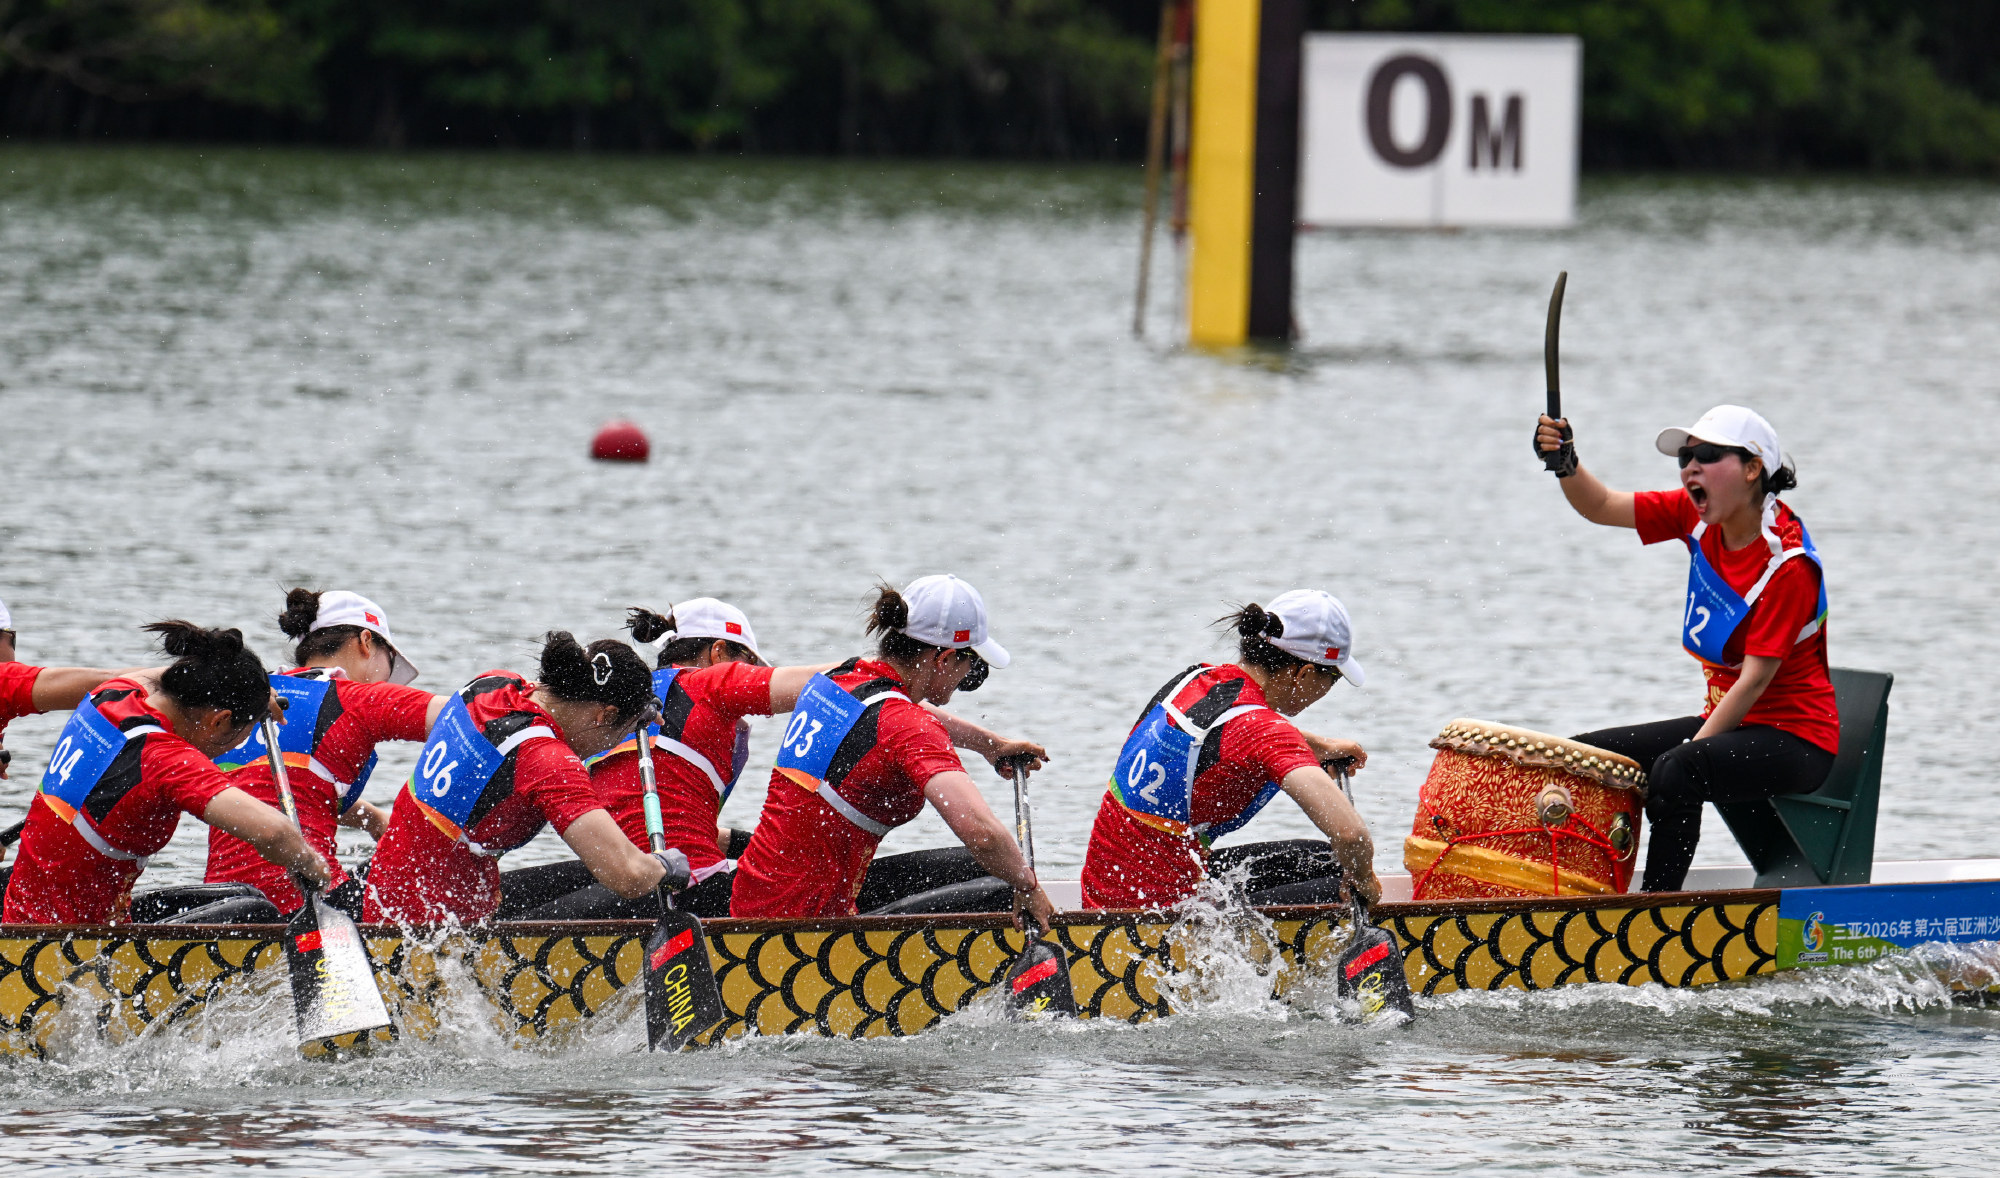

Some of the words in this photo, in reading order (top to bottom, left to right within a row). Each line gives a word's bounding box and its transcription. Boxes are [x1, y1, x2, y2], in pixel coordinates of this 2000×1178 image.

[1685, 591, 1711, 648] 12
[49, 735, 84, 786] 04
[783, 711, 823, 758] 03
[423, 740, 459, 798] 06
[1128, 749, 1166, 806] 02
[1832, 919, 1912, 941] 三亚2026年
[1832, 946, 1854, 959] The
[1857, 945, 1877, 959] 6th
[664, 964, 695, 1036] CHINA
